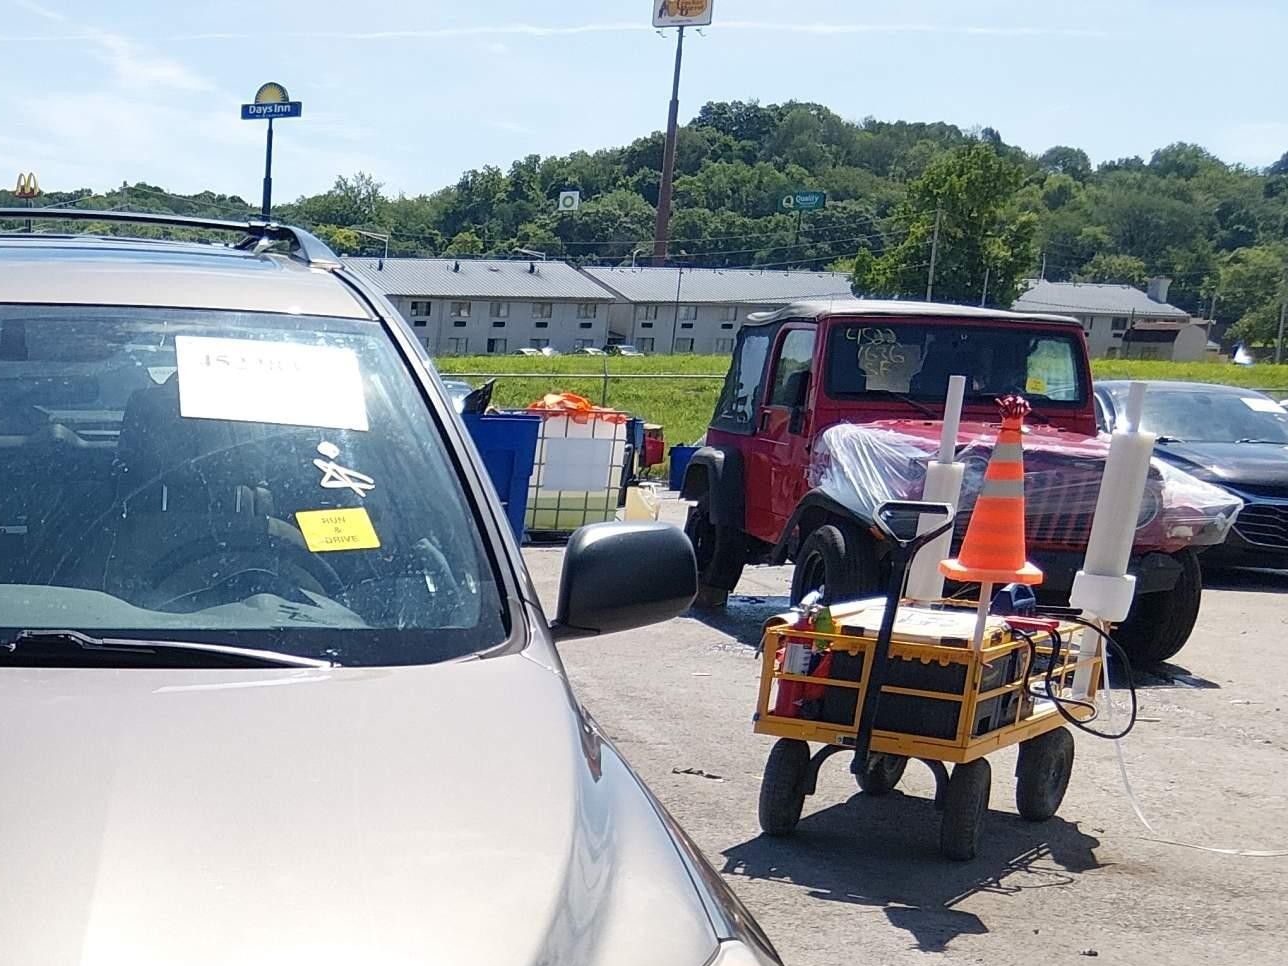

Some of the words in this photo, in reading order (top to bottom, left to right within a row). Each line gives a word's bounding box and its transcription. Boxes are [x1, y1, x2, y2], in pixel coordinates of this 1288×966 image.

[248, 104, 273, 116] Days
[274, 104, 291, 113] Inn
[795, 194, 820, 204] Quality
[320, 516, 347, 525] RUN
[324, 535, 361, 545] DRIVE
